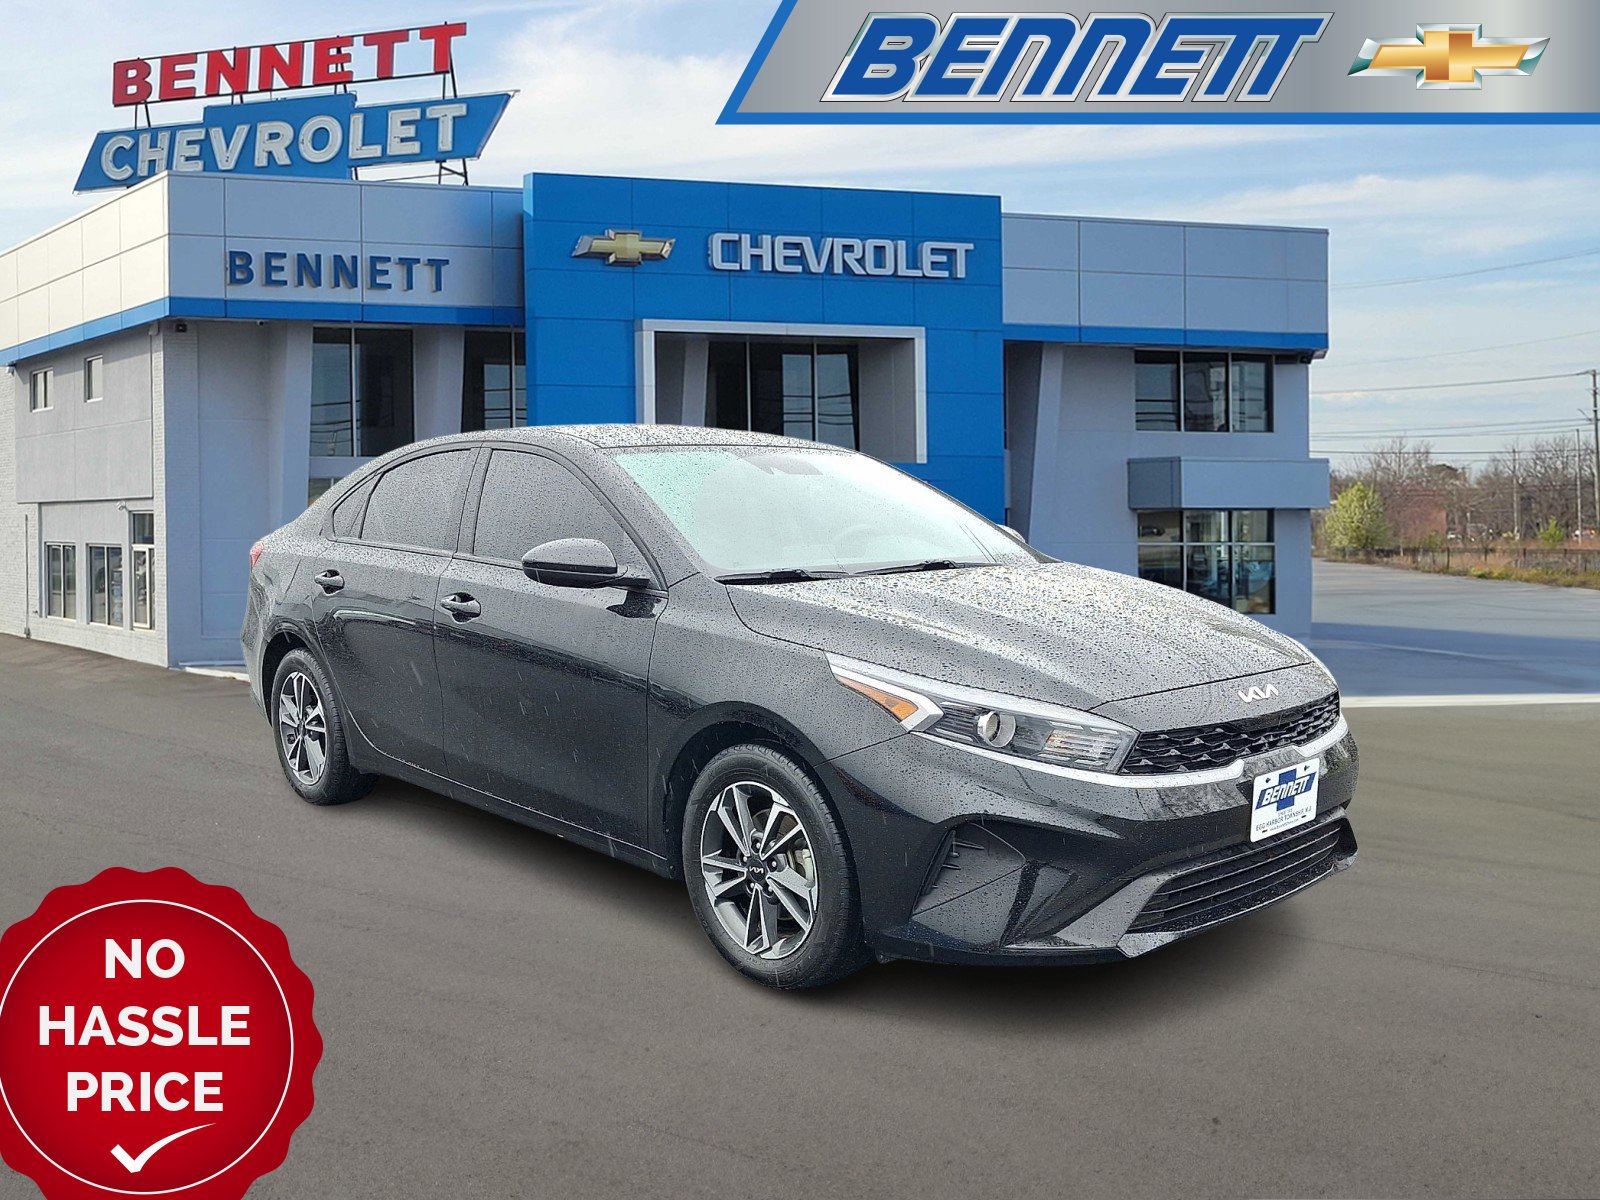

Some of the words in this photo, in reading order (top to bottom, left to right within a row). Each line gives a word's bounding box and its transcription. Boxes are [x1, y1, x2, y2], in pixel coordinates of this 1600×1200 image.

[113, 22, 467, 107] BENNETT
[100, 103, 469, 181] CHEVROLET
[227, 249, 450, 292] BENNETT
[709, 232, 975, 279] CHEVROLET
[1261, 775, 1311, 806] BENNETT
